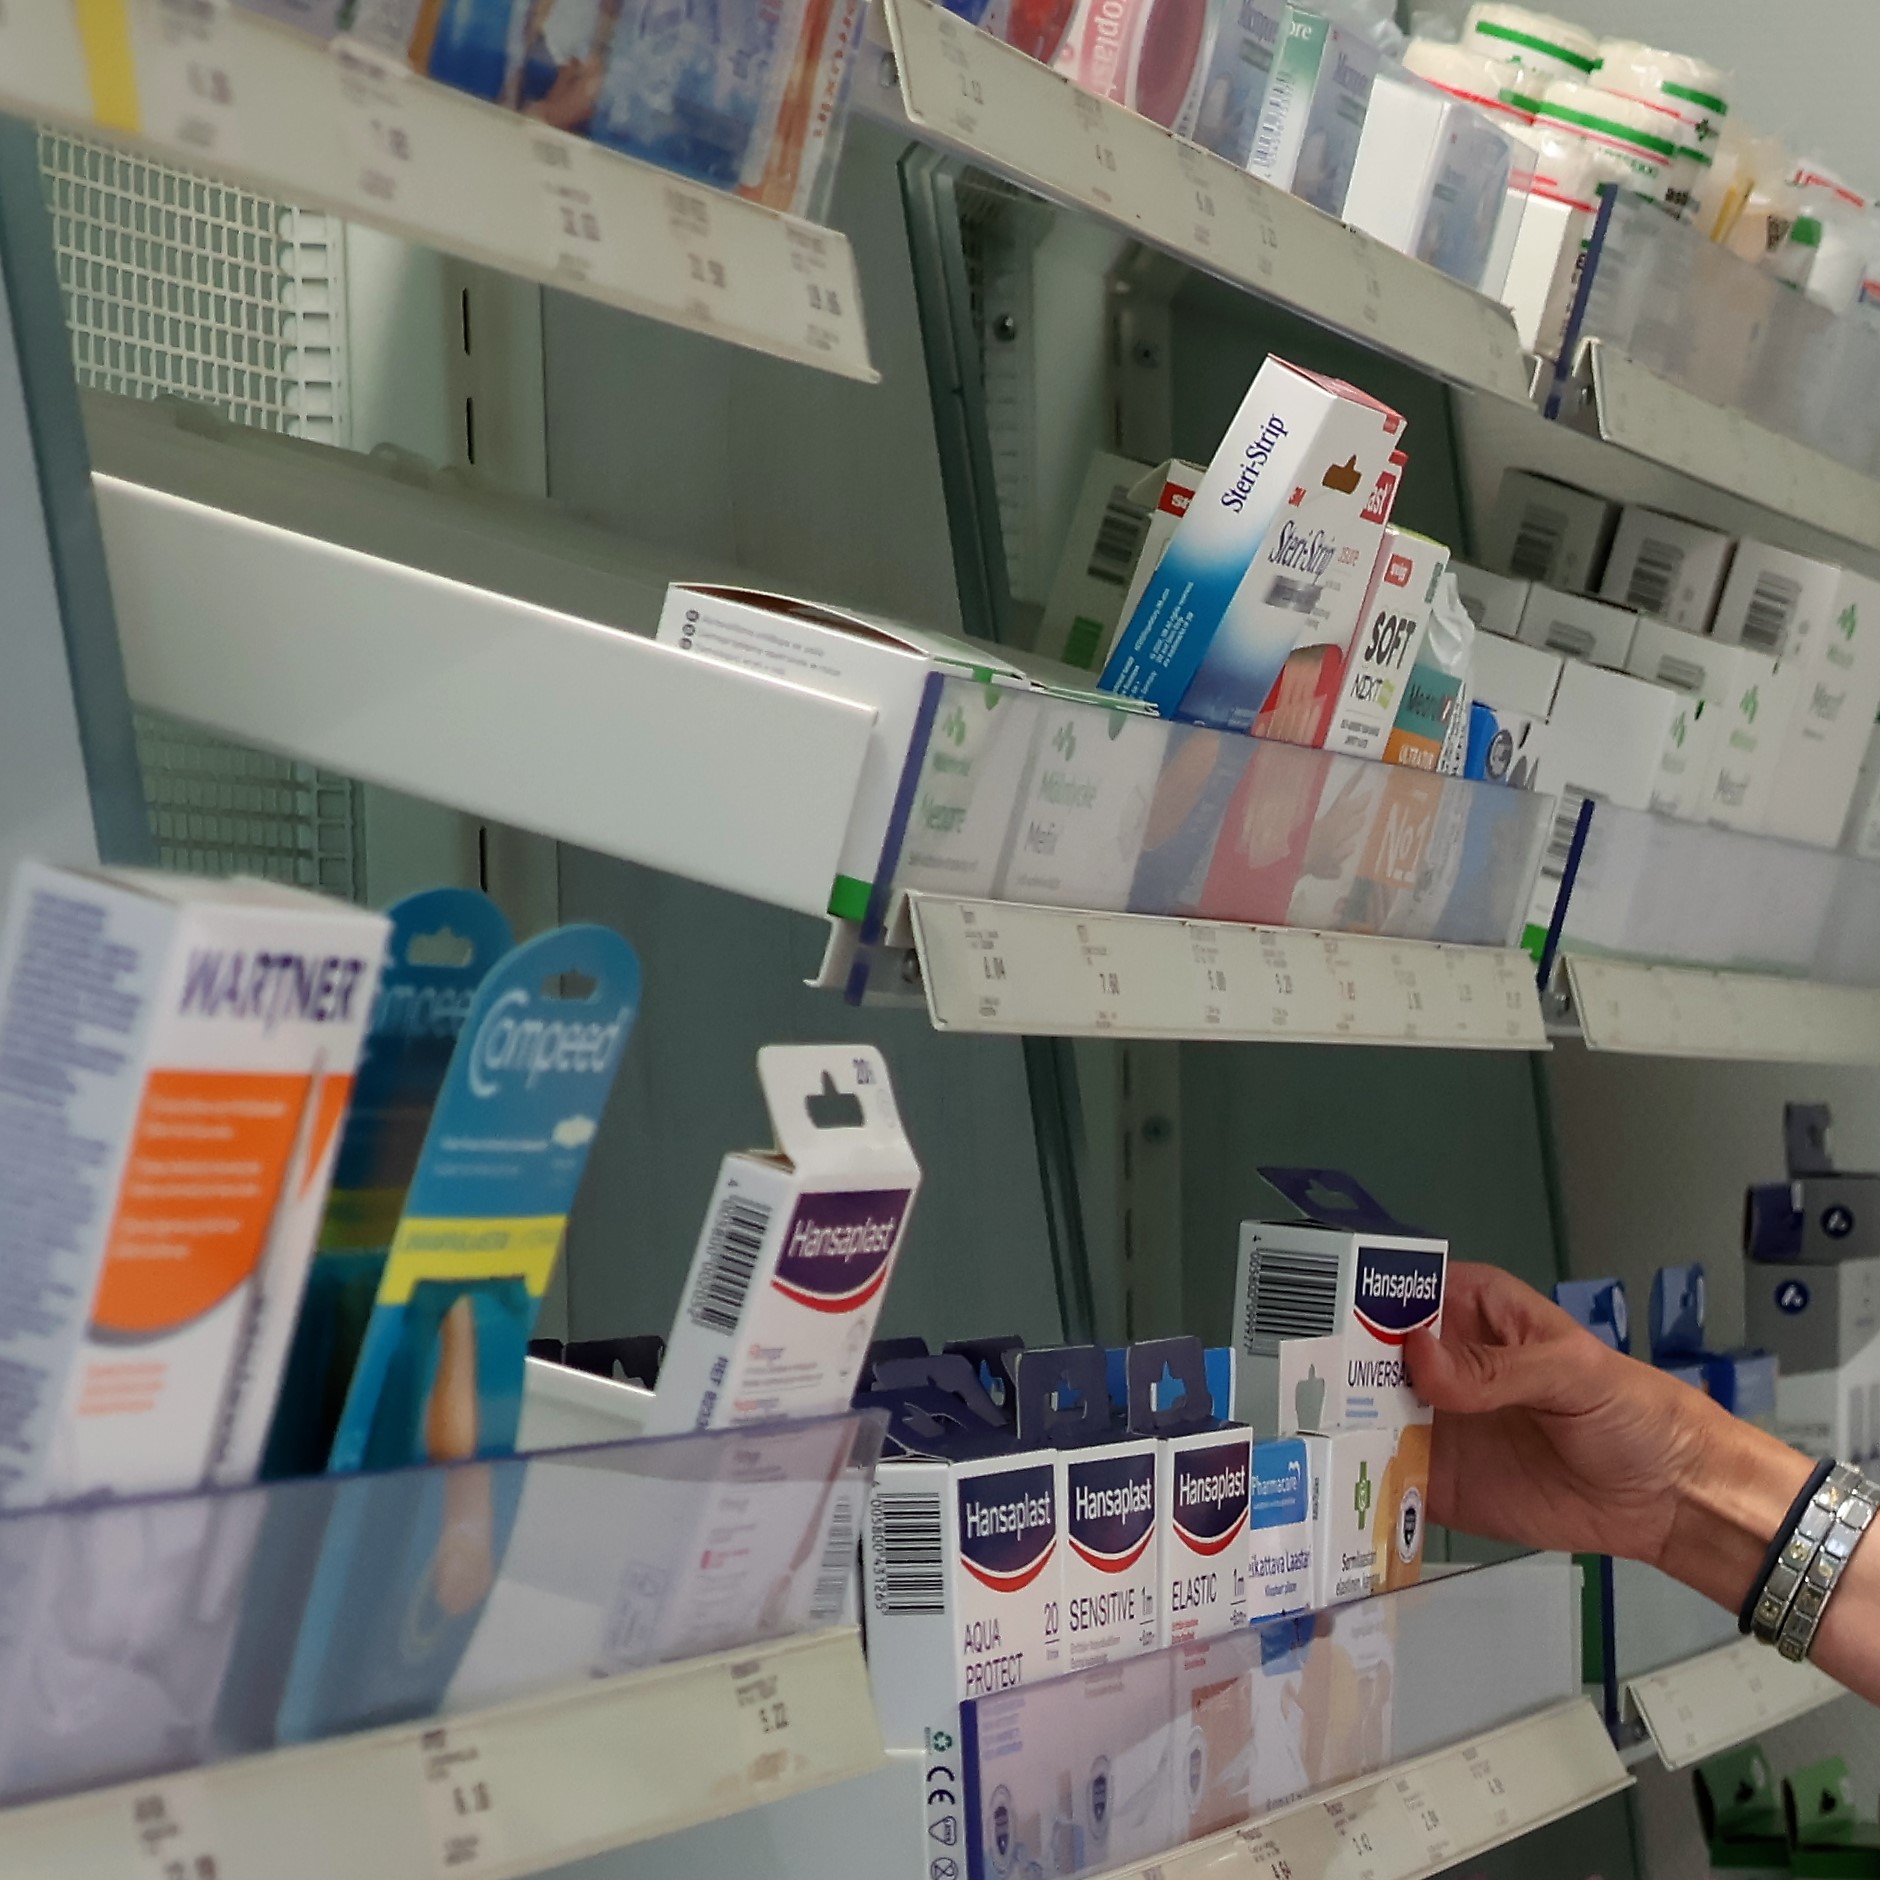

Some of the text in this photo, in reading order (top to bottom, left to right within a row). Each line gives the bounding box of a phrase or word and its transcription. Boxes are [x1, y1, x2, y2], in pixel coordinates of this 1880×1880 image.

[1221, 413, 1289, 514] Steri-Strip
[1268, 520, 1337, 588] Steri-Strip
[1364, 610, 1417, 670] SOFT
[1350, 673, 1384, 703] NEXT
[178, 948, 368, 1036] WARTNER
[469, 990, 634, 1098] Compeed
[788, 1216, 896, 1264] Hansaplast
[1362, 1266, 1438, 1308] Hansaplast
[1075, 1477, 1152, 1525] Hansaplast
[1179, 1464, 1246, 1511] Hansaplast
[966, 1494, 1051, 1541] Hansaplast
[1249, 1553, 1285, 1578] ikattava
[1069, 1588, 1135, 1632] SENSITIVE
[1172, 1573, 1218, 1612] ELASTIC
[964, 1602, 1059, 1655] AQUA 20
[965, 1652, 1024, 1697] PROTECT
